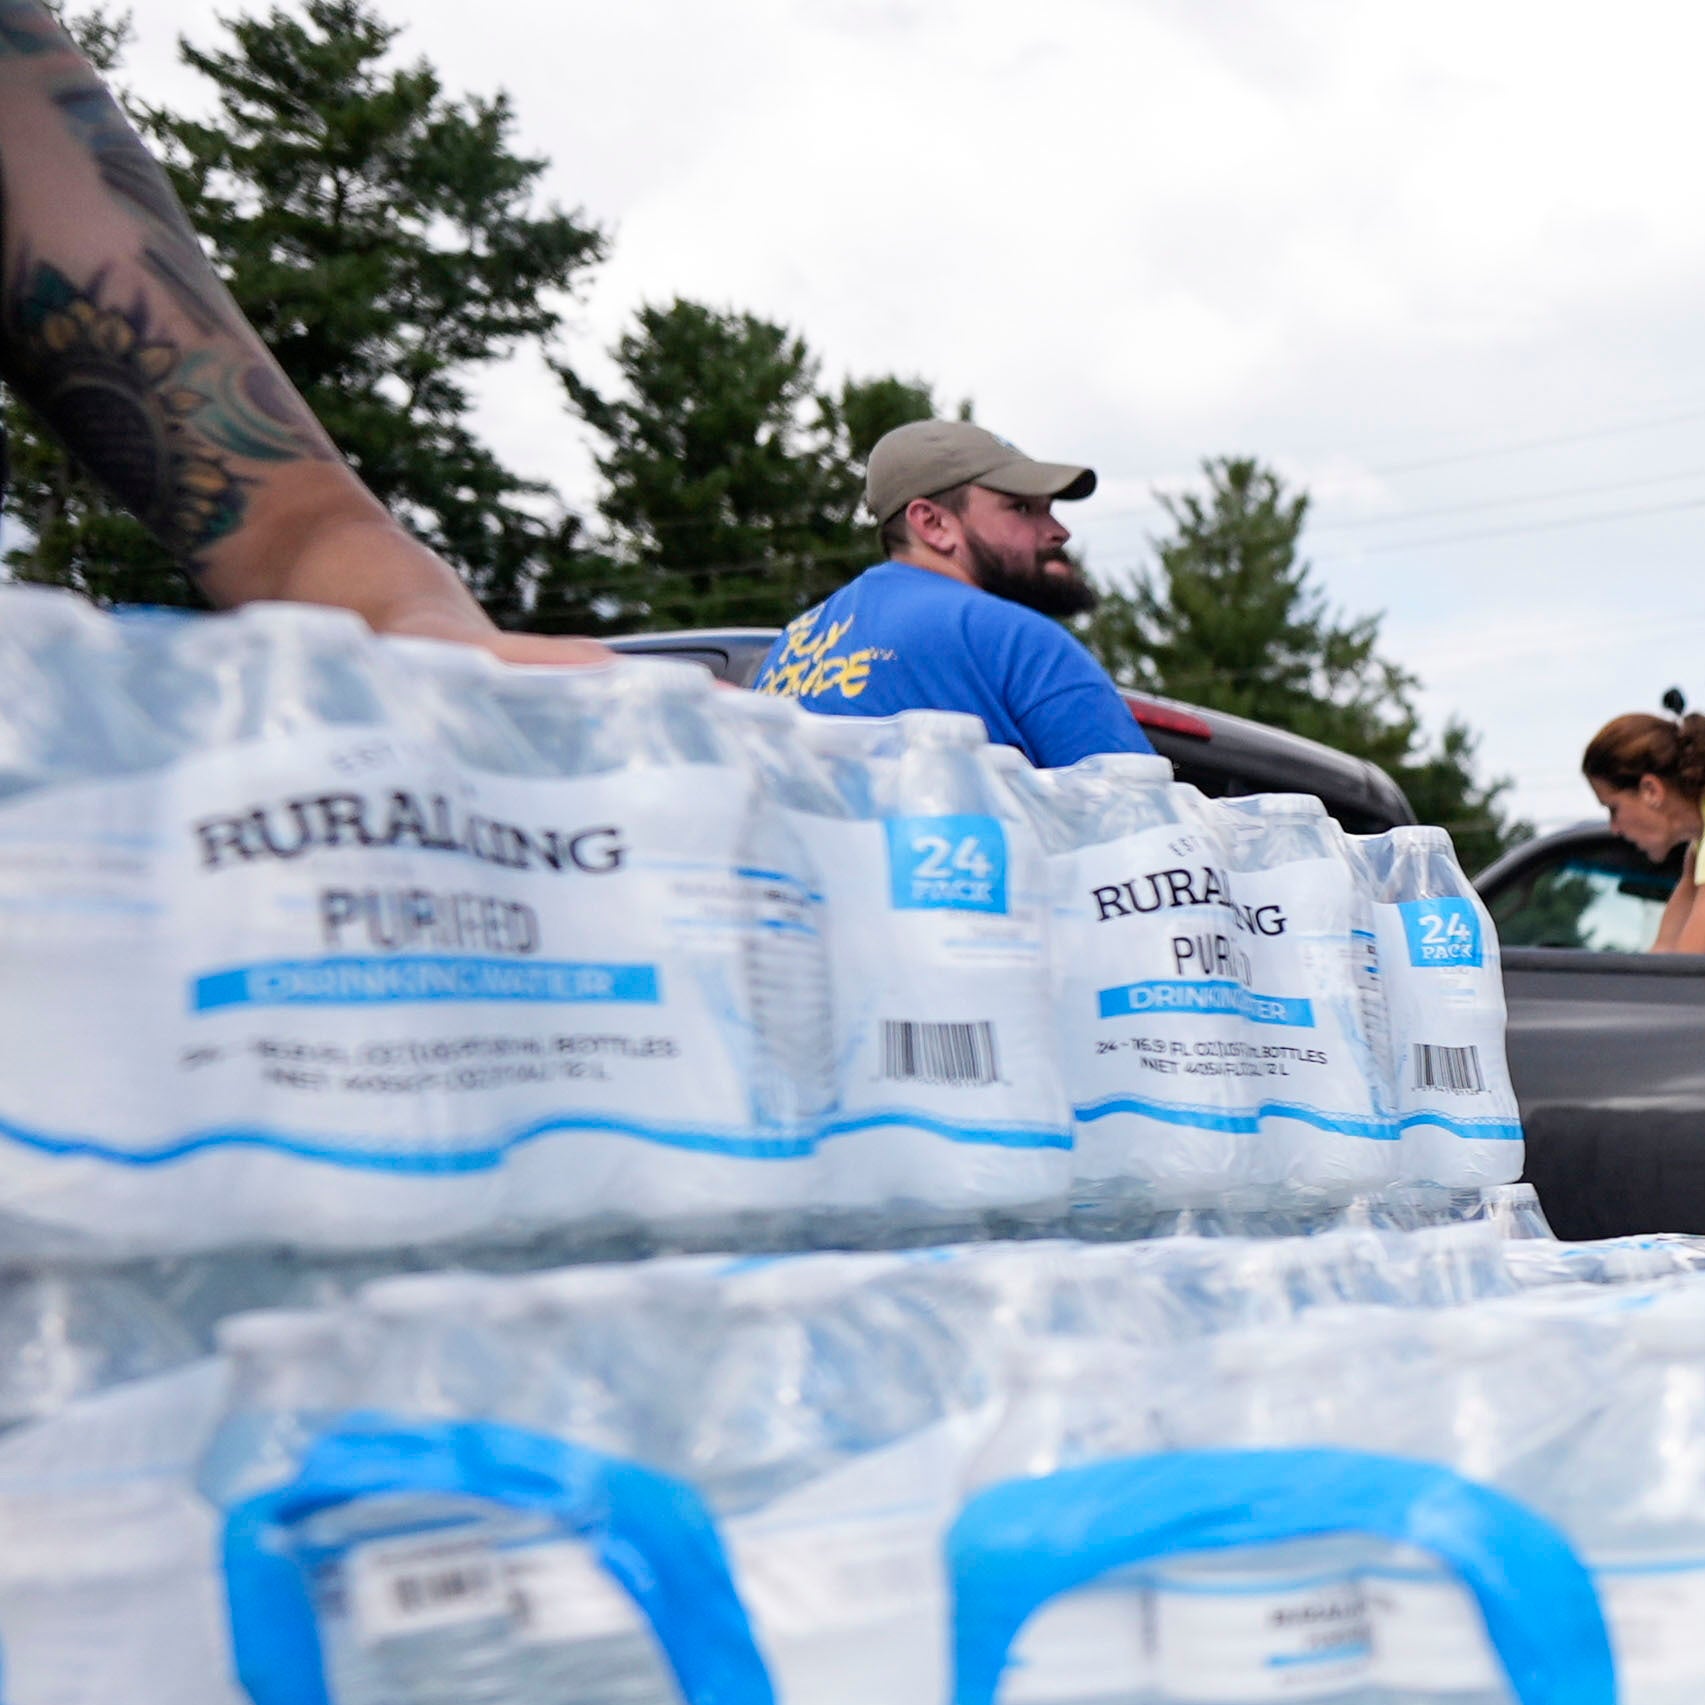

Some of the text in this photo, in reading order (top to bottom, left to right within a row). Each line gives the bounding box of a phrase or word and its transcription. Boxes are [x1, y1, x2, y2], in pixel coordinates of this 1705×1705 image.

[911, 836, 991, 879] 24
[1418, 912, 1472, 945] 24
[1420, 943, 1473, 960] PACK
